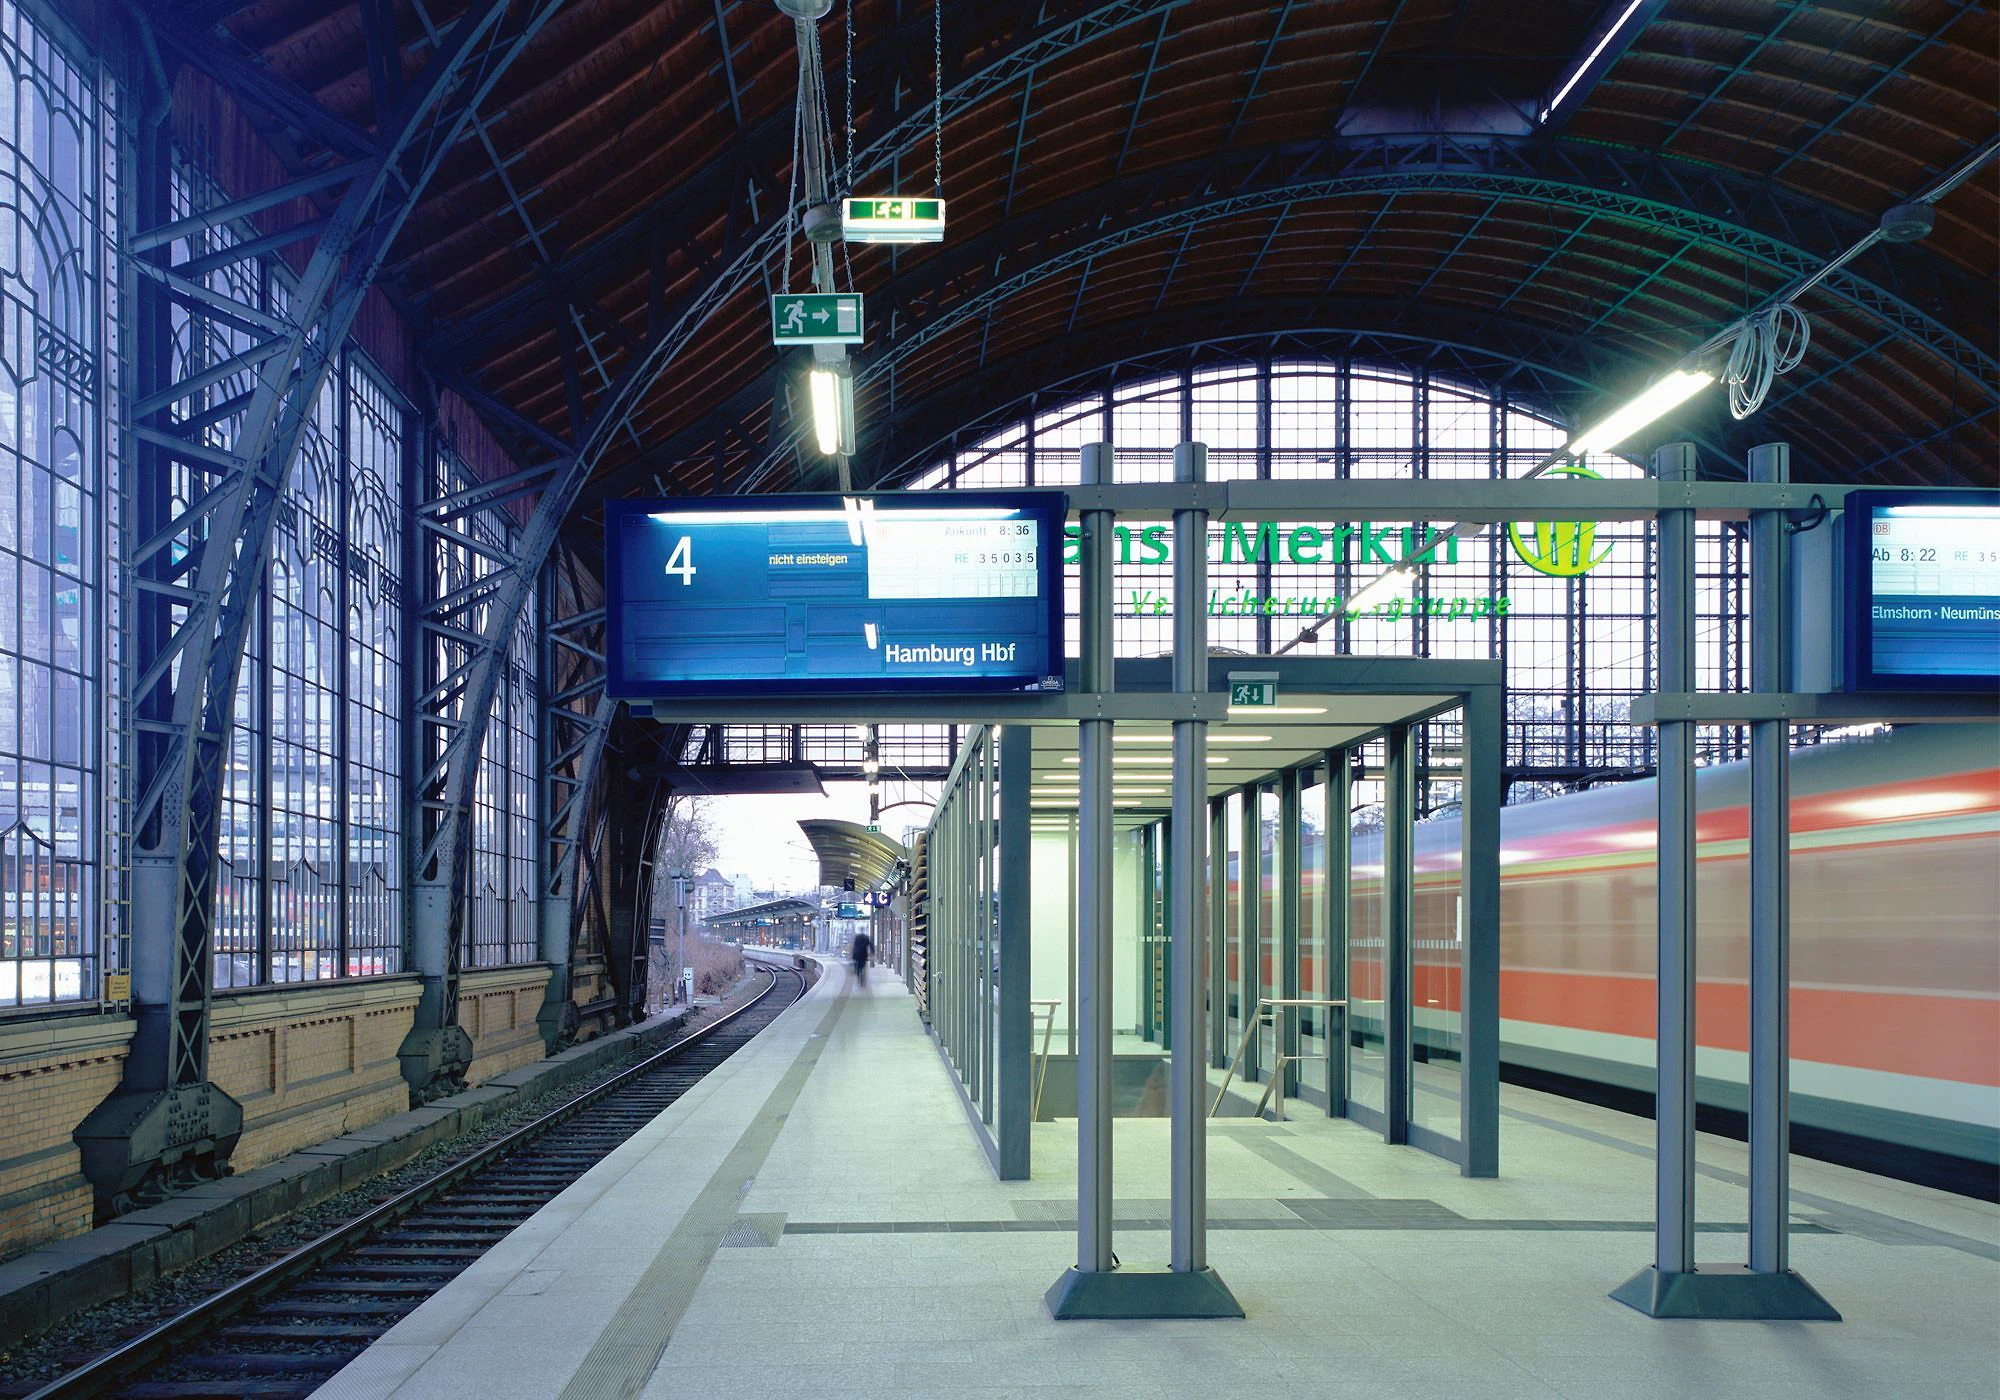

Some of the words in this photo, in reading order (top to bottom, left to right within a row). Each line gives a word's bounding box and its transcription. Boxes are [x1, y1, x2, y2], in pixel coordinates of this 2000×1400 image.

[944, 525, 987, 537] Ankunft
[1875, 524, 1889, 534] DB
[665, 536, 697, 586] 4
[769, 554, 794, 565] nicht
[796, 553, 848, 567] einsteigen
[954, 553, 970, 564] RE
[1872, 548, 1890, 561] Ab
[1954, 551, 1969, 561] RE
[1872, 606, 1932, 619] Elmshorn
[885, 643, 976, 666] Hamburg
[981, 643, 1016, 662] Hbf
[865, 892, 873, 904] 4
[879, 892, 888, 904] C
